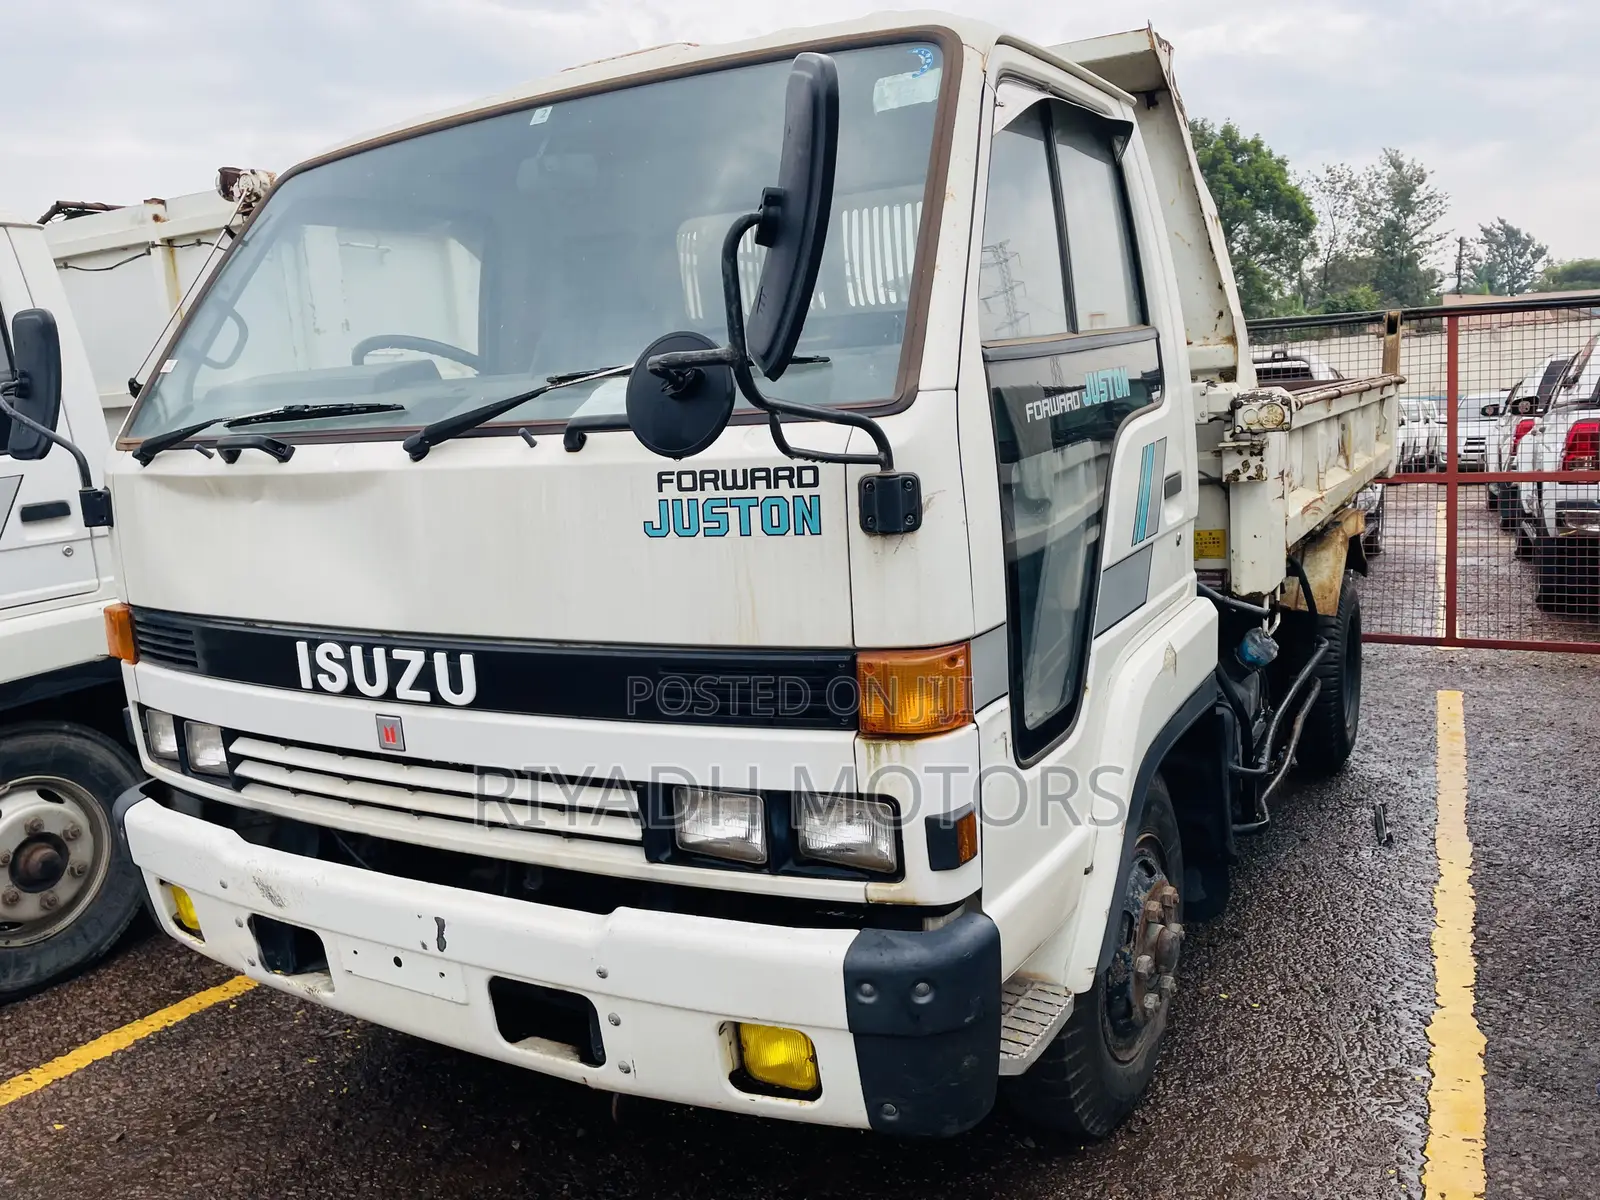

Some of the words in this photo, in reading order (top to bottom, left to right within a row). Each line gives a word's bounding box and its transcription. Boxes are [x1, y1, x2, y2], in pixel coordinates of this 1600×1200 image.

[1025, 390, 1081, 423] FORWARD
[1081, 366, 1131, 407] JUSTON
[657, 465, 820, 493] FORWARD
[643, 495, 822, 538] JUSTON
[295, 640, 477, 706] ISUZU
